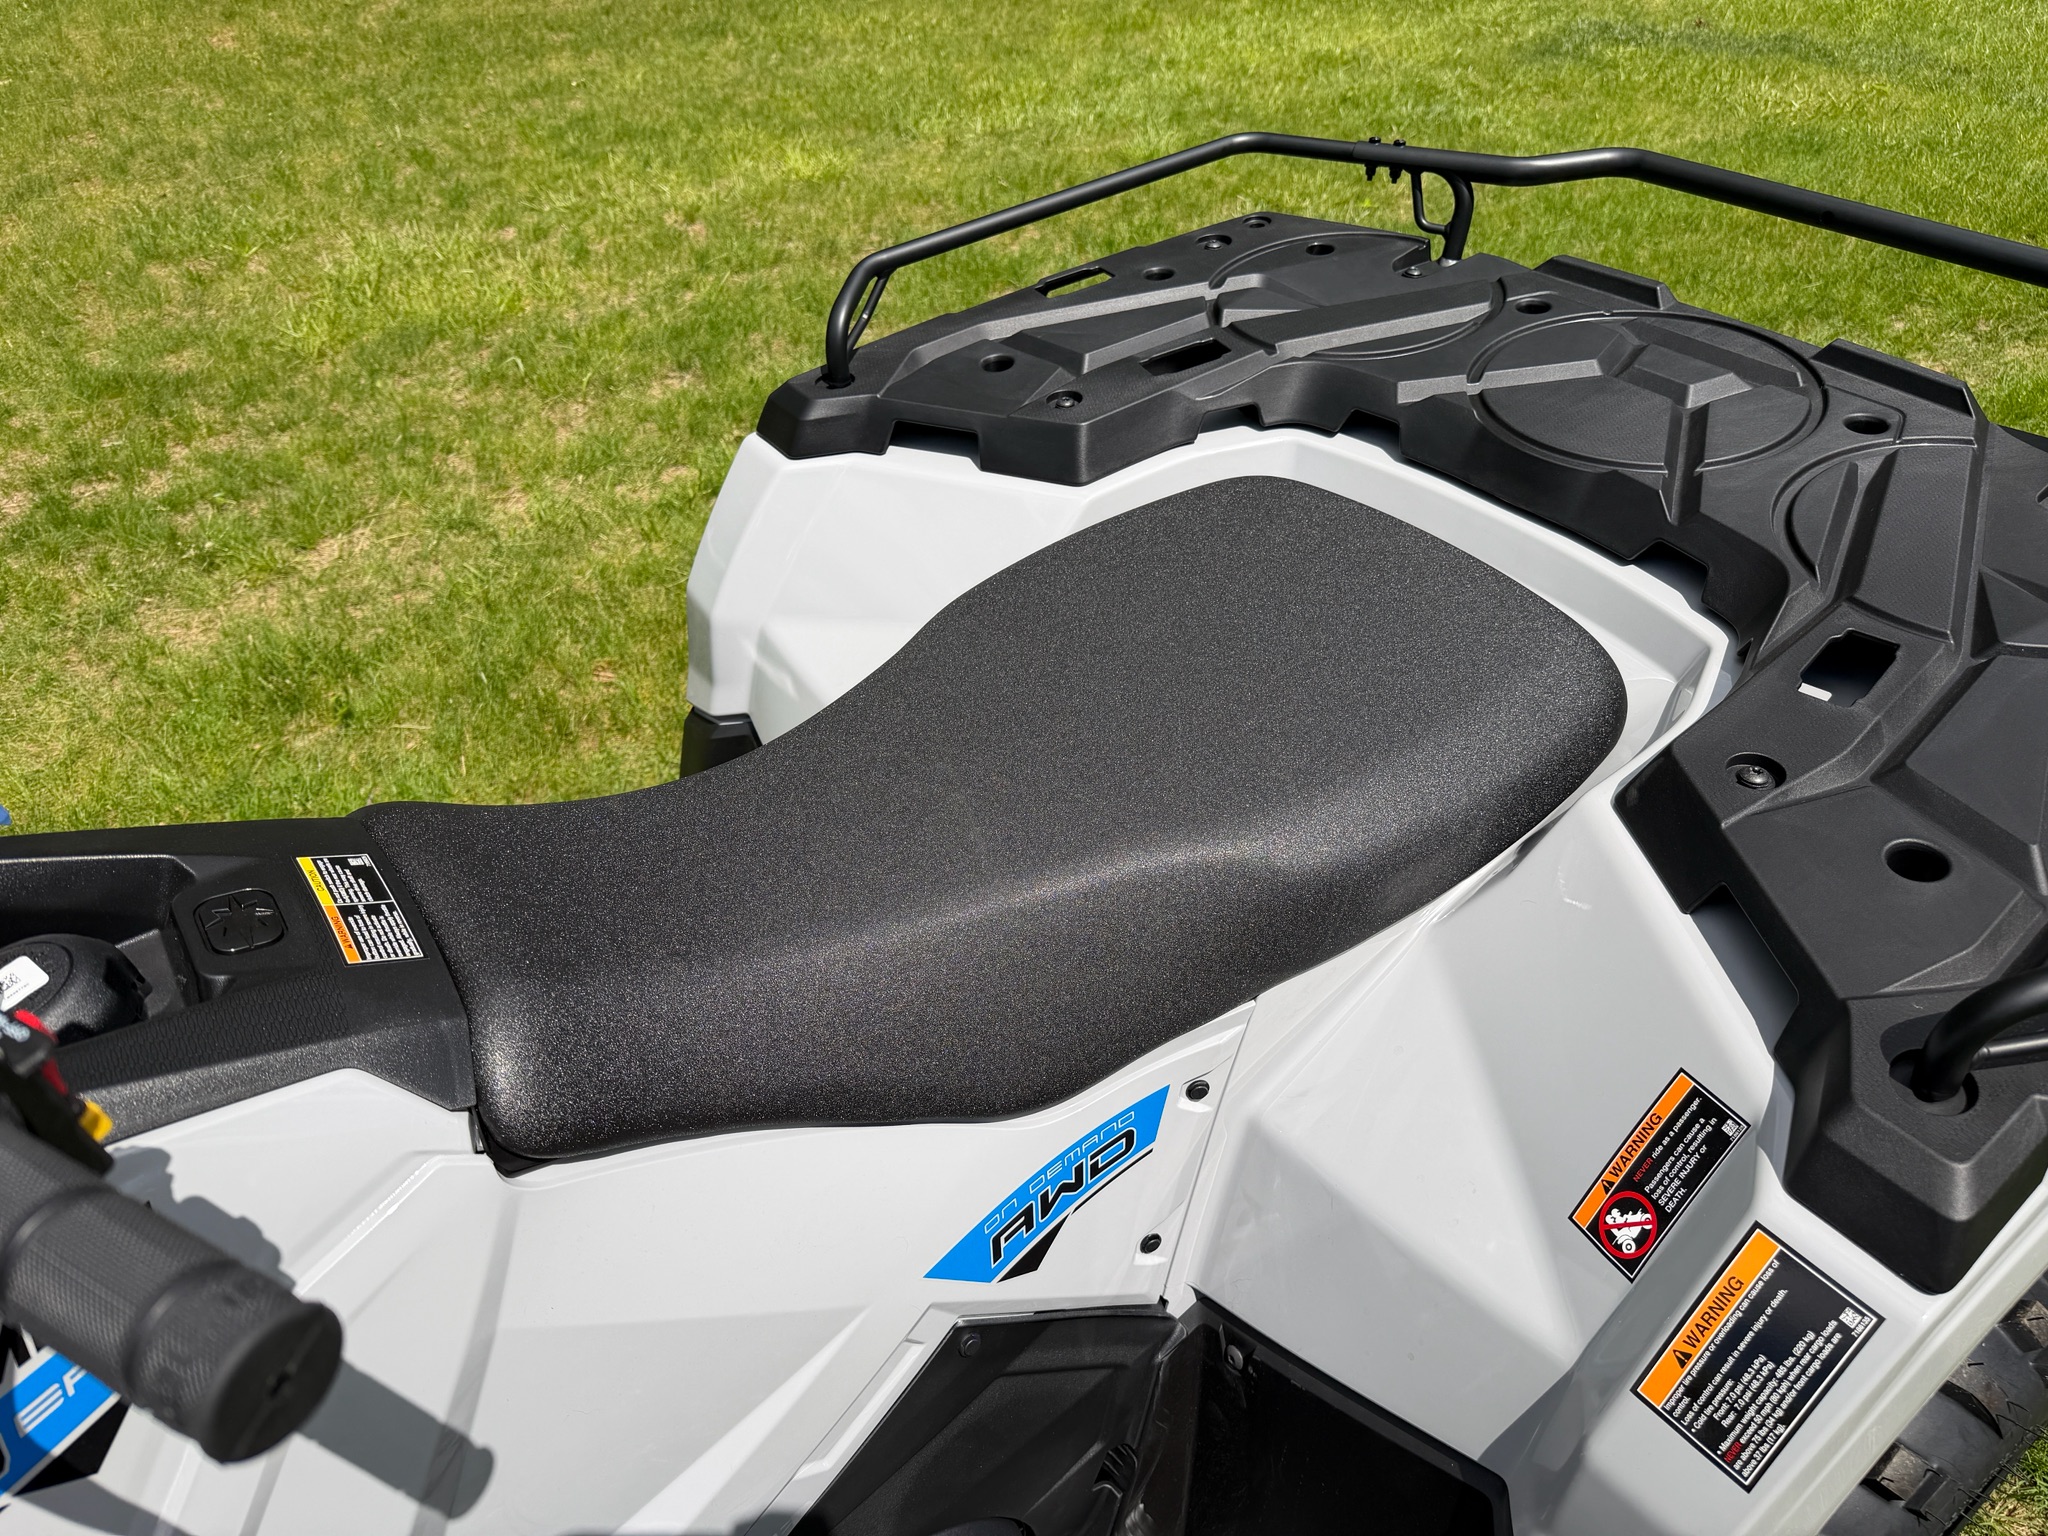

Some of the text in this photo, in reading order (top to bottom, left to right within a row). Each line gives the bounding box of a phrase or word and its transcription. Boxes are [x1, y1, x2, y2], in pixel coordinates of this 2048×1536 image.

[308, 870, 325, 891] CAUTION
[331, 916, 349, 946] WARNING
[984, 1111, 1135, 1234] ON DEMAND
[1608, 1113, 1662, 1177] WARNING
[1633, 1157, 1653, 1182] NEVER
[1651, 1145, 1663, 1159] ride
[1672, 1097, 1702, 1132] passenger.
[1644, 1155, 1675, 1193] Passengers
[1683, 1123, 1700, 1143] cause
[1650, 1185, 1664, 1200] loss
[1668, 1153, 1690, 1178] control,
[1687, 1124, 1712, 1153] resulting
[990, 1128, 1136, 1268] AWD
[1658, 1177, 1681, 1206] SEVERE
[1678, 1152, 1700, 1179] INJURY
[1664, 1187, 1687, 1212] DEATH.
[1663, 1384, 1685, 1410] Improper
[1681, 1375, 1693, 1386] tire
[1690, 1350, 1711, 1377] pressure
[1713, 1309, 1742, 1344] overloading
[1747, 1280, 1764, 1299] cause
[1760, 1267, 1774, 1281] loss
[1682, 1276, 1744, 1348] WARNING
[1680, 1410, 1695, 1425] Loss
[1697, 1382, 1714, 1405] control
[1719, 1355, 1735, 1374] result
[1737, 1330, 1755, 1351] severe
[1750, 1313, 1768, 1332] injury
[1770, 1289, 1788, 1308] death.
[1672, 1395, 1690, 1417] control.
[1693, 1378, 1734, 1429] Cold tire pressure:
